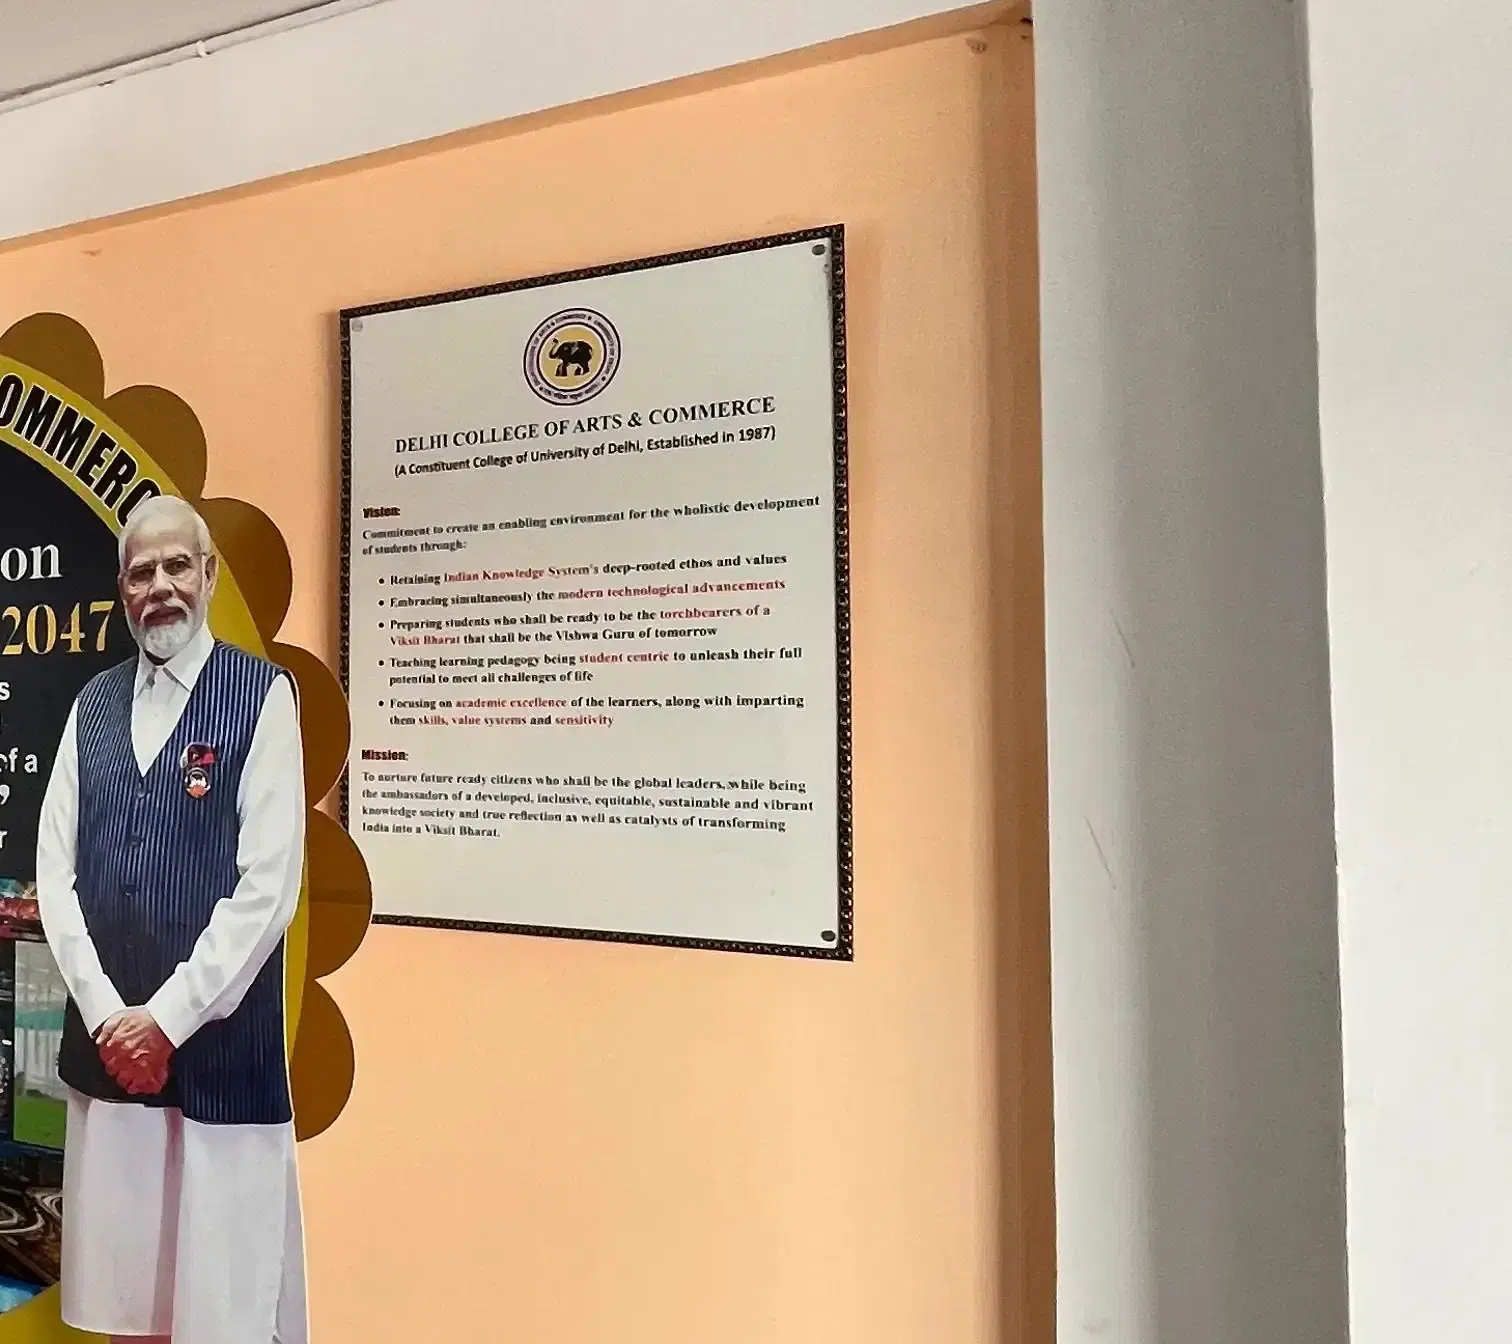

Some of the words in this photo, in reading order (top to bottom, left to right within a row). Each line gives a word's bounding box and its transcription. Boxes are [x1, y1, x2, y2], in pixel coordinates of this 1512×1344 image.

[396, 434, 447, 453] DELHI
[453, 424, 539, 446] COLLEGE
[544, 420, 569, 436] OF
[573, 414, 622, 433] ARTS
[628, 412, 642, 427] &
[649, 396, 775, 424] COMMERCE
[395, 465, 406, 478] (A
[409, 459, 470, 474] Constituent
[473, 455, 513, 468] College
[516, 451, 528, 464] of
[531, 447, 589, 462] University
[592, 443, 605, 456] of
[608, 440, 643, 454] Delhi,
[647, 432, 718, 450] Established
[723, 432, 734, 442] in
[739, 425, 775, 441] 1987)
[24, 754, 37, 773] a
